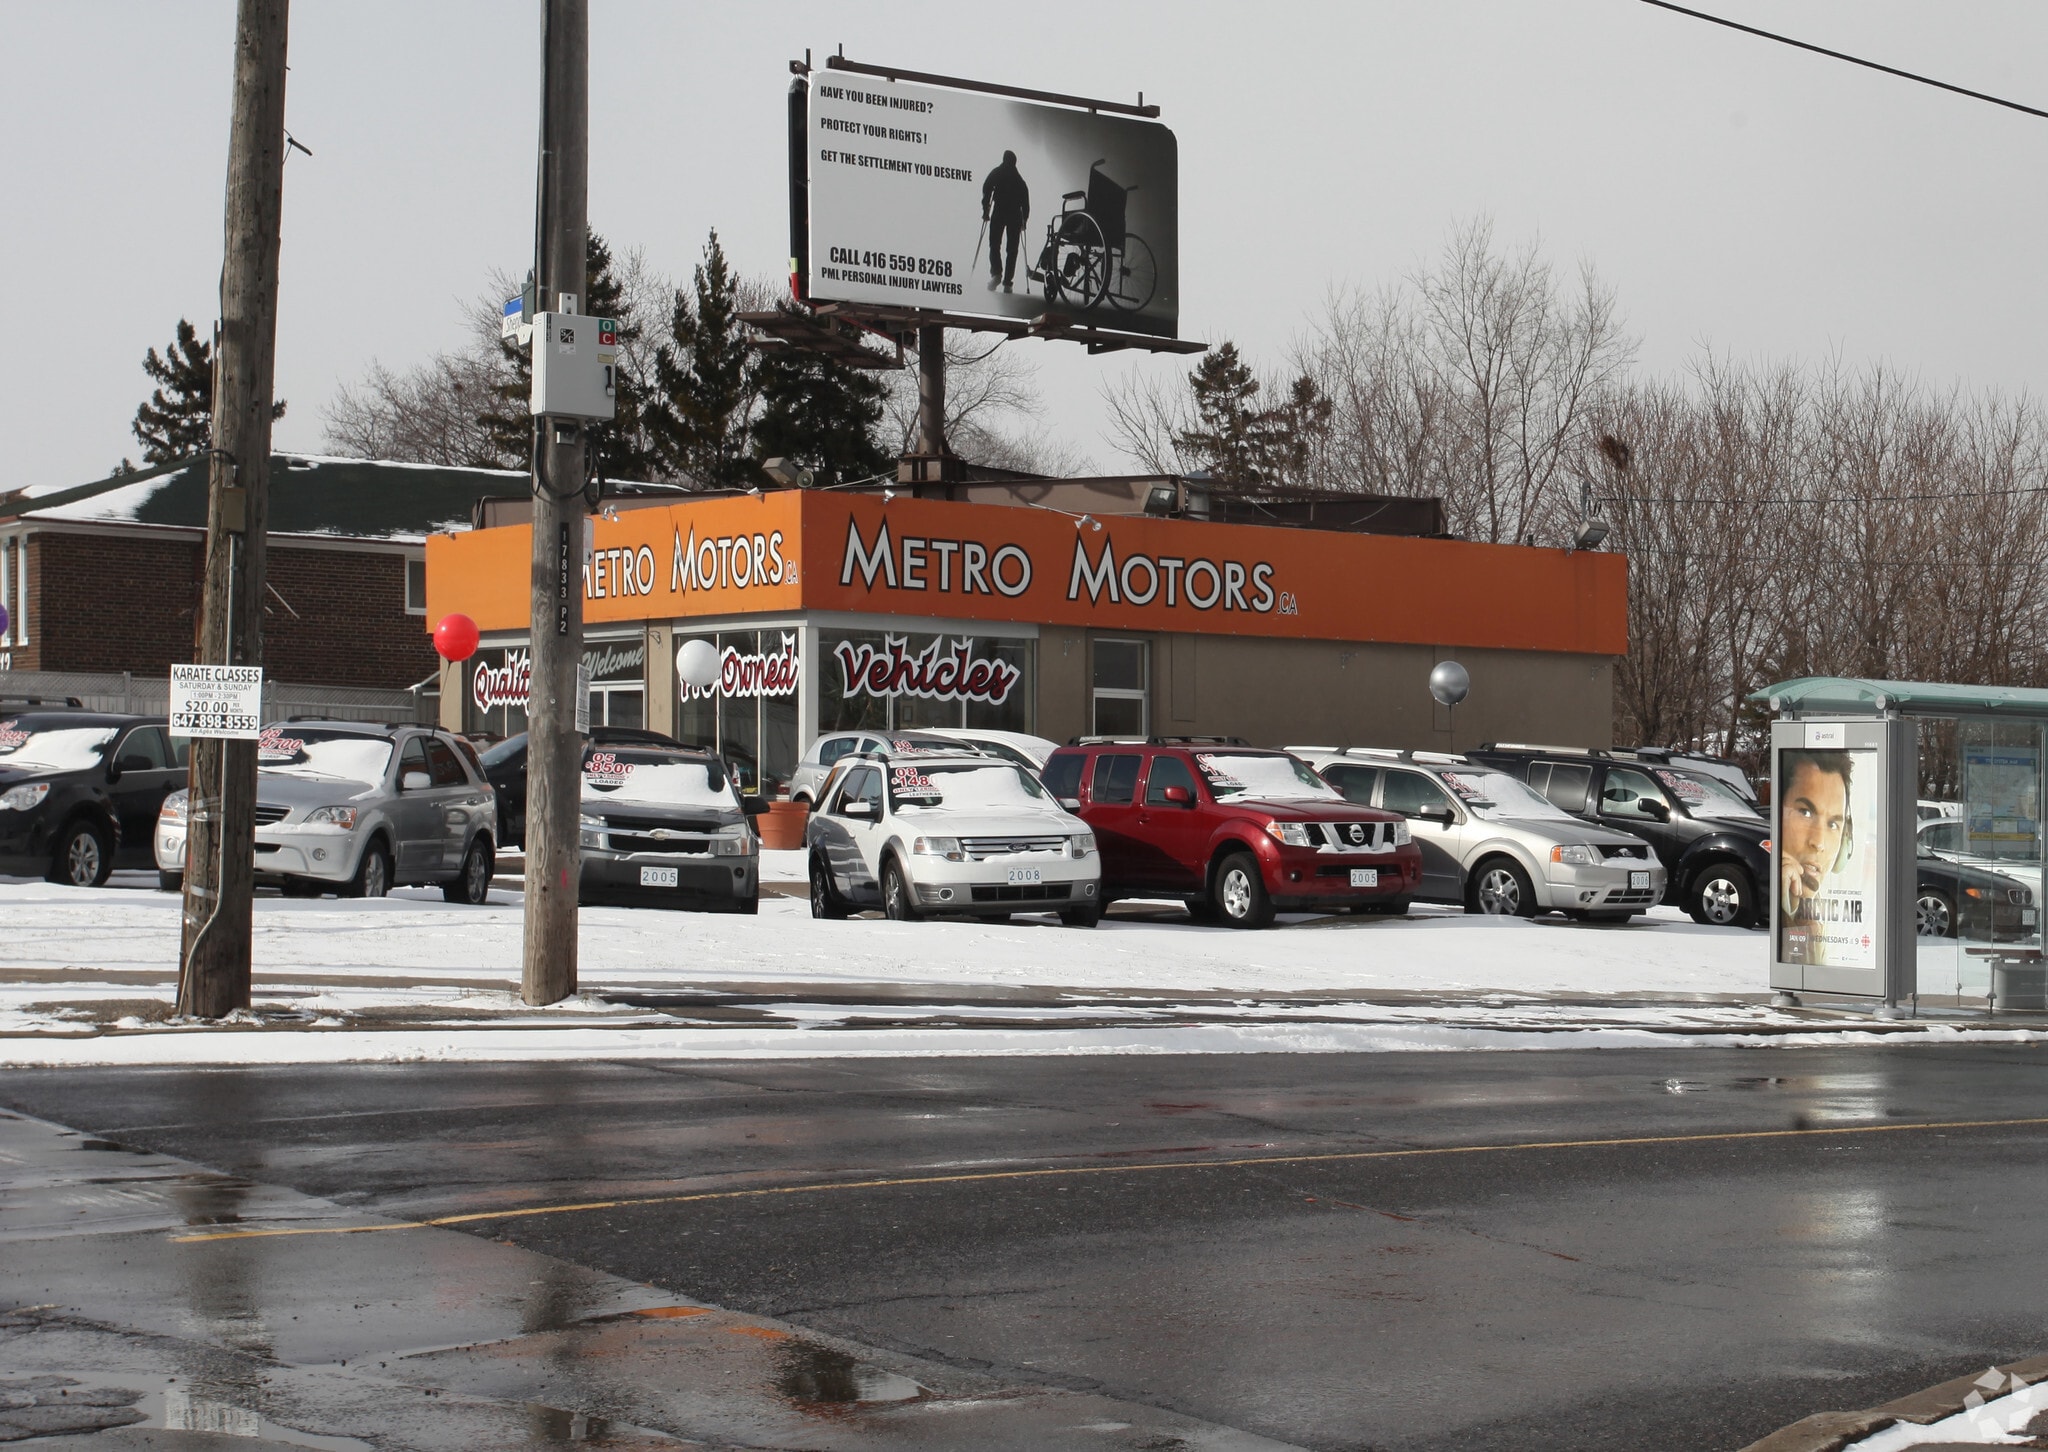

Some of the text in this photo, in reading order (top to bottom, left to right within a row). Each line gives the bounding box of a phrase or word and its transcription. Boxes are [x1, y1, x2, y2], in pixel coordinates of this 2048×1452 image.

[820, 86, 934, 113] HAVE YOU BEEN INJURED?
[820, 117, 861, 134] PROTECT
[862, 123, 887, 138] YOUR
[889, 127, 922, 143] RIGHTS
[821, 149, 972, 182] GET THE SETTLEMENT YOU DESERVE
[830, 246, 953, 277] CALL 416 559 8268
[821, 267, 962, 295] PML PERSONAL INJURY LAWYERS
[602, 321, 612, 331] O
[602, 333, 611, 344] C
[839, 511, 1033, 598] METRO
[582, 645, 644, 679] Welcome
[833, 633, 1021, 705] Vehicles
[173, 667, 260, 683] KARATE CLASSES
[179, 682, 252, 691] SATURDAY & SUNDAY
[185, 700, 229, 713] $20.00
[173, 714, 257, 729] 647-898-8559
[593, 753, 616, 763] 05
[895, 767, 917, 778] 08
[642, 871, 676, 883] 2005
[1009, 870, 1040, 881] 2008
[1352, 872, 1377, 883] 2005
[1799, 897, 1863, 923] ARCTIC AIR
